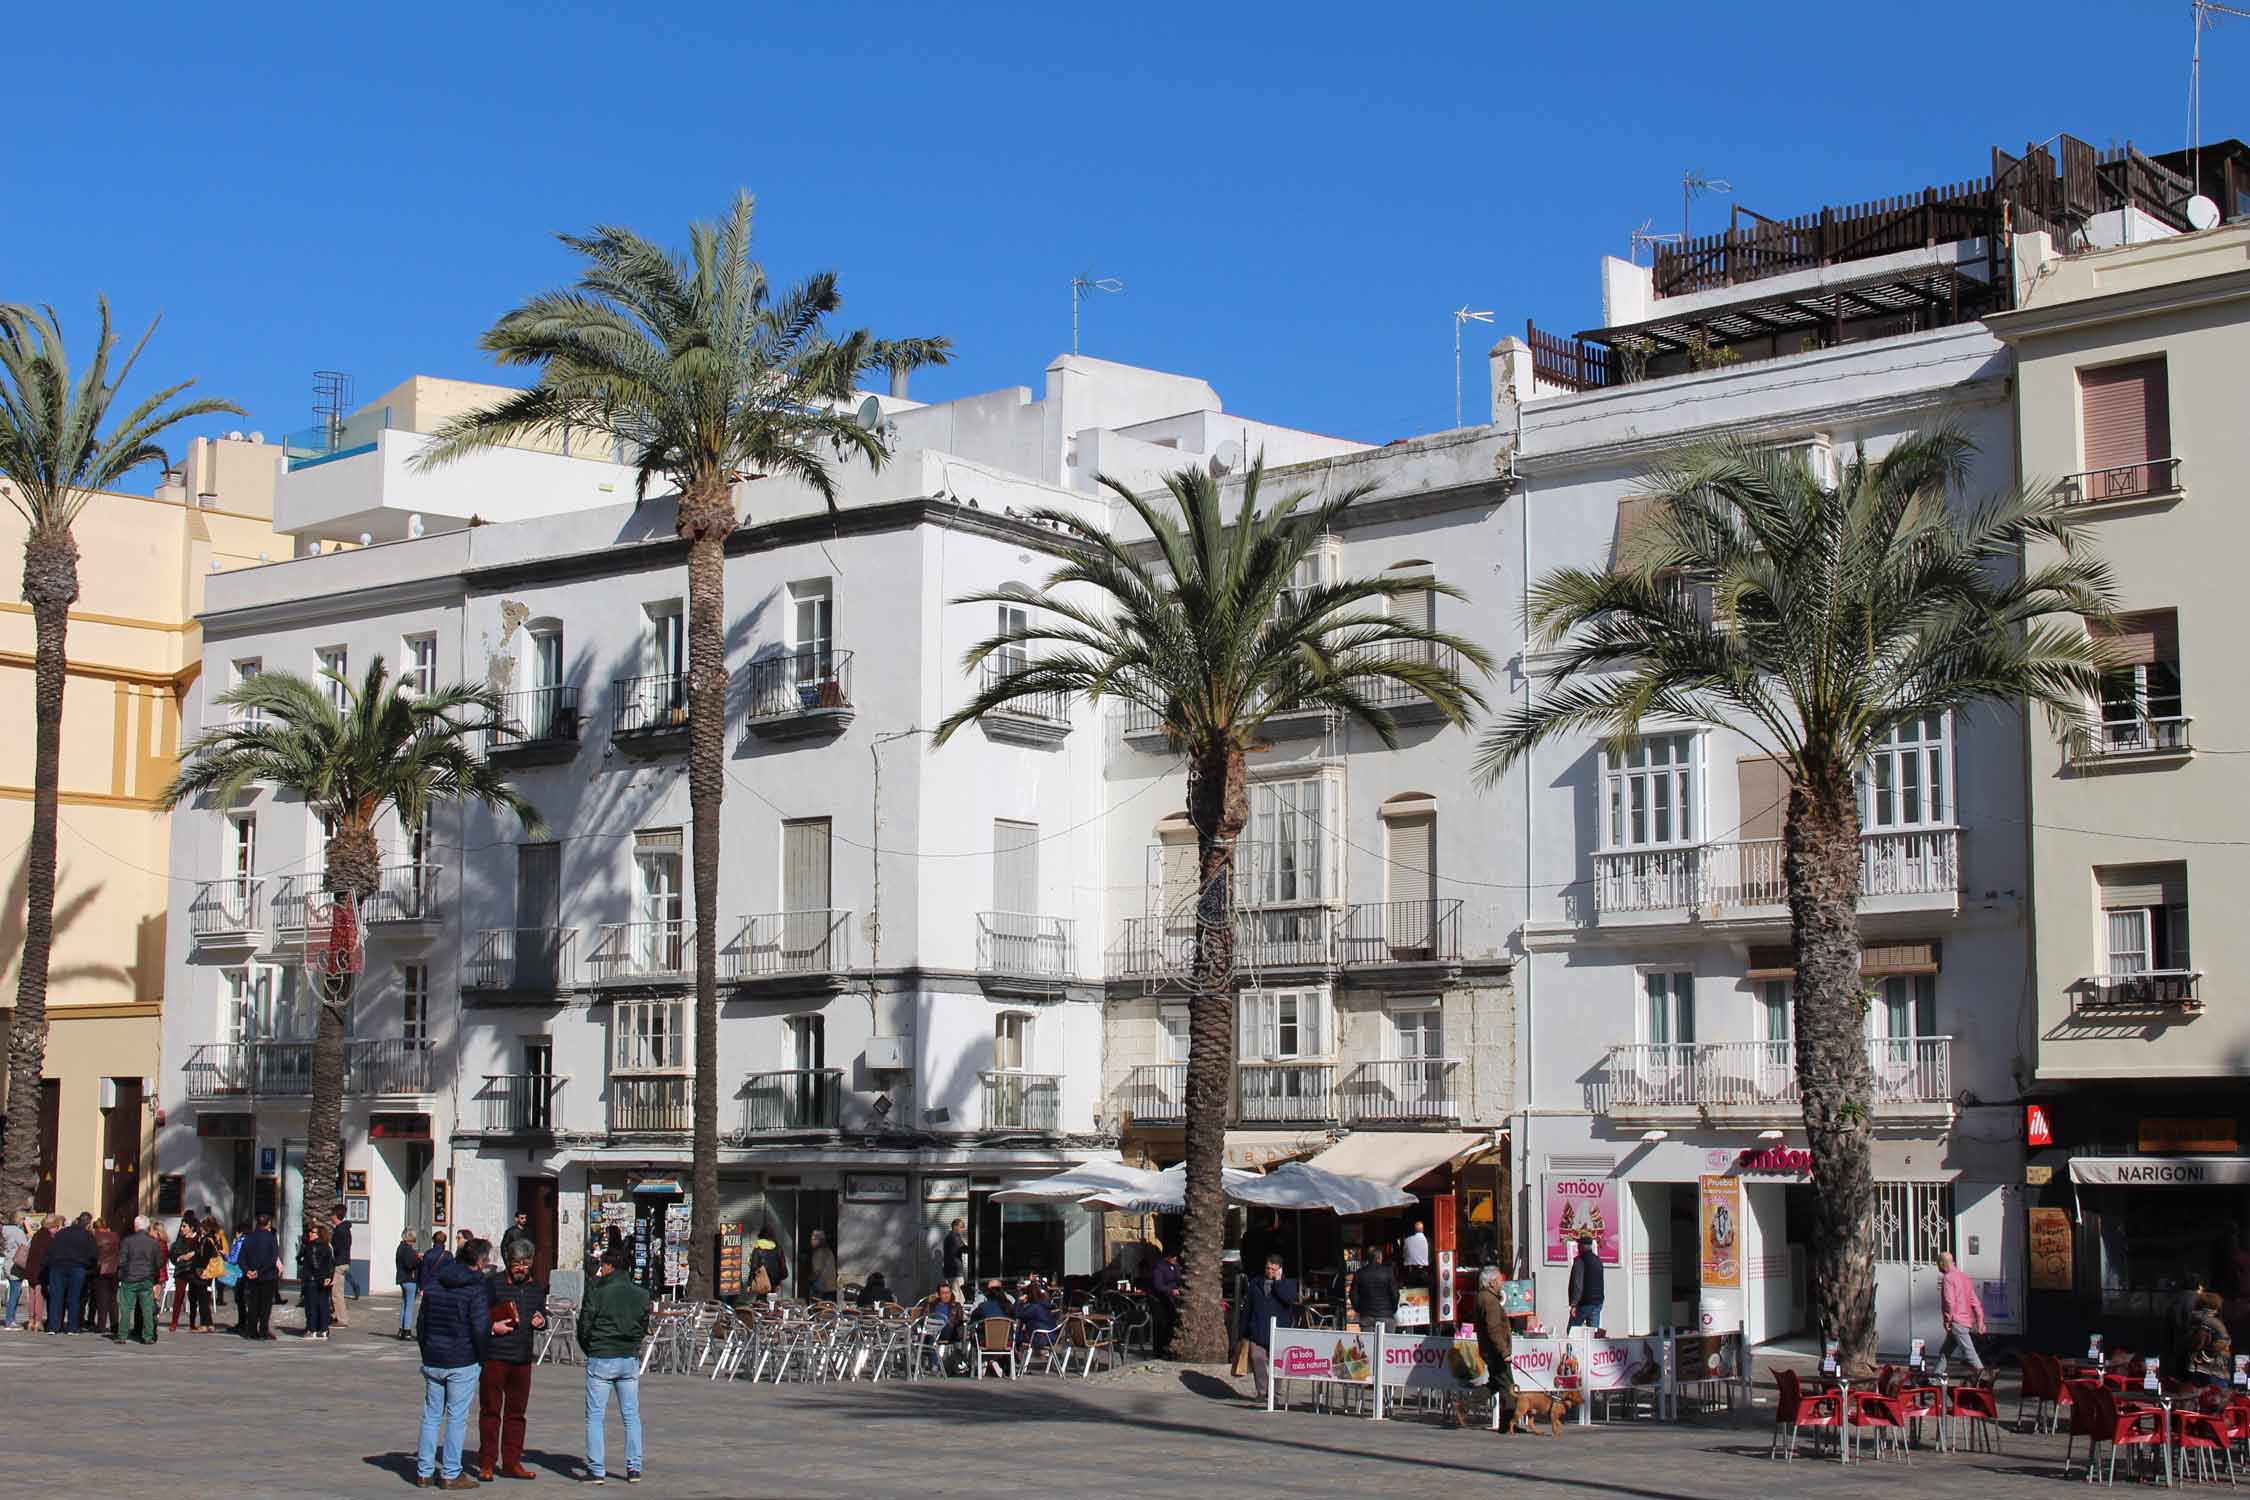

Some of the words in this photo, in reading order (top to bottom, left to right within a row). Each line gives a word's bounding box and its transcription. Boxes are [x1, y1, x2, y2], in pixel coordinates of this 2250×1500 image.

[2030, 1110, 2049, 1143] illy
[1739, 1143, 1814, 1176] smöoy
[2118, 1166, 2204, 1181] NARIGONI
[1557, 1178, 1605, 1198] smöoy
[1385, 1343, 1447, 1368] smöoy
[1512, 1346, 1553, 1371] smöoy
[1592, 1345, 1629, 1366] smöoy
